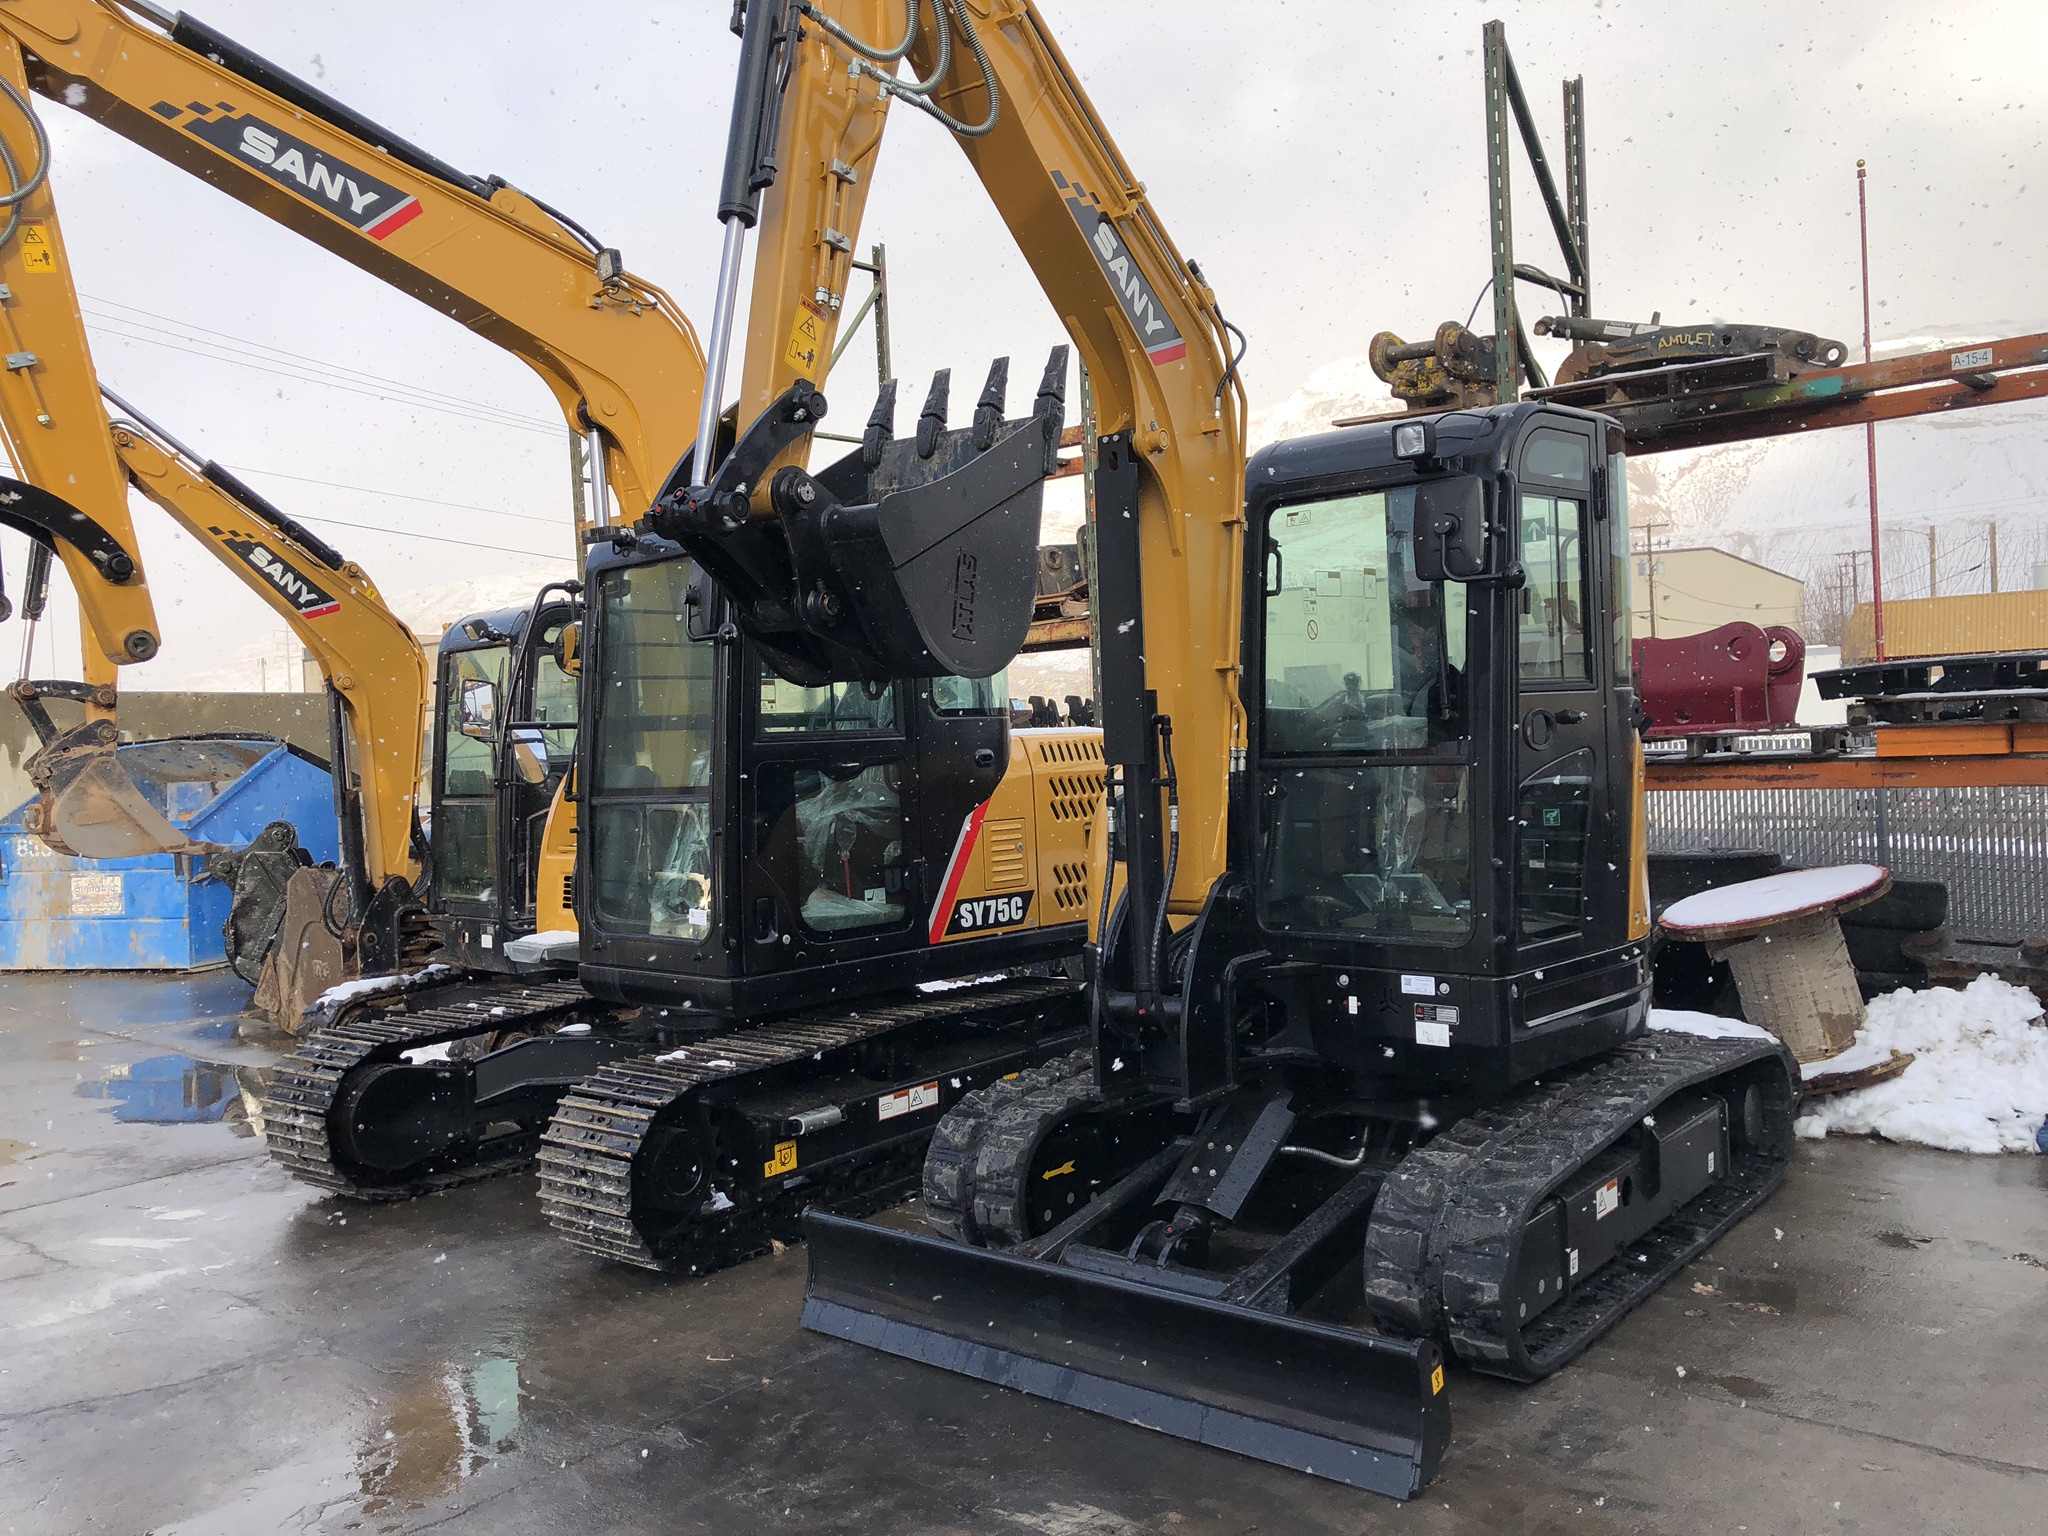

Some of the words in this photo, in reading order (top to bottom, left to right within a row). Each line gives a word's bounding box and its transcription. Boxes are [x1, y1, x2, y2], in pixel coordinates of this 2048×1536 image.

[239, 126, 380, 215] SANY
[1093, 221, 1165, 336] SANY
[1658, 332, 1715, 351] AMULET
[1953, 350, 1989, 367] A-15-4
[248, 546, 319, 604] SANY
[960, 896, 1023, 928] SY75C
